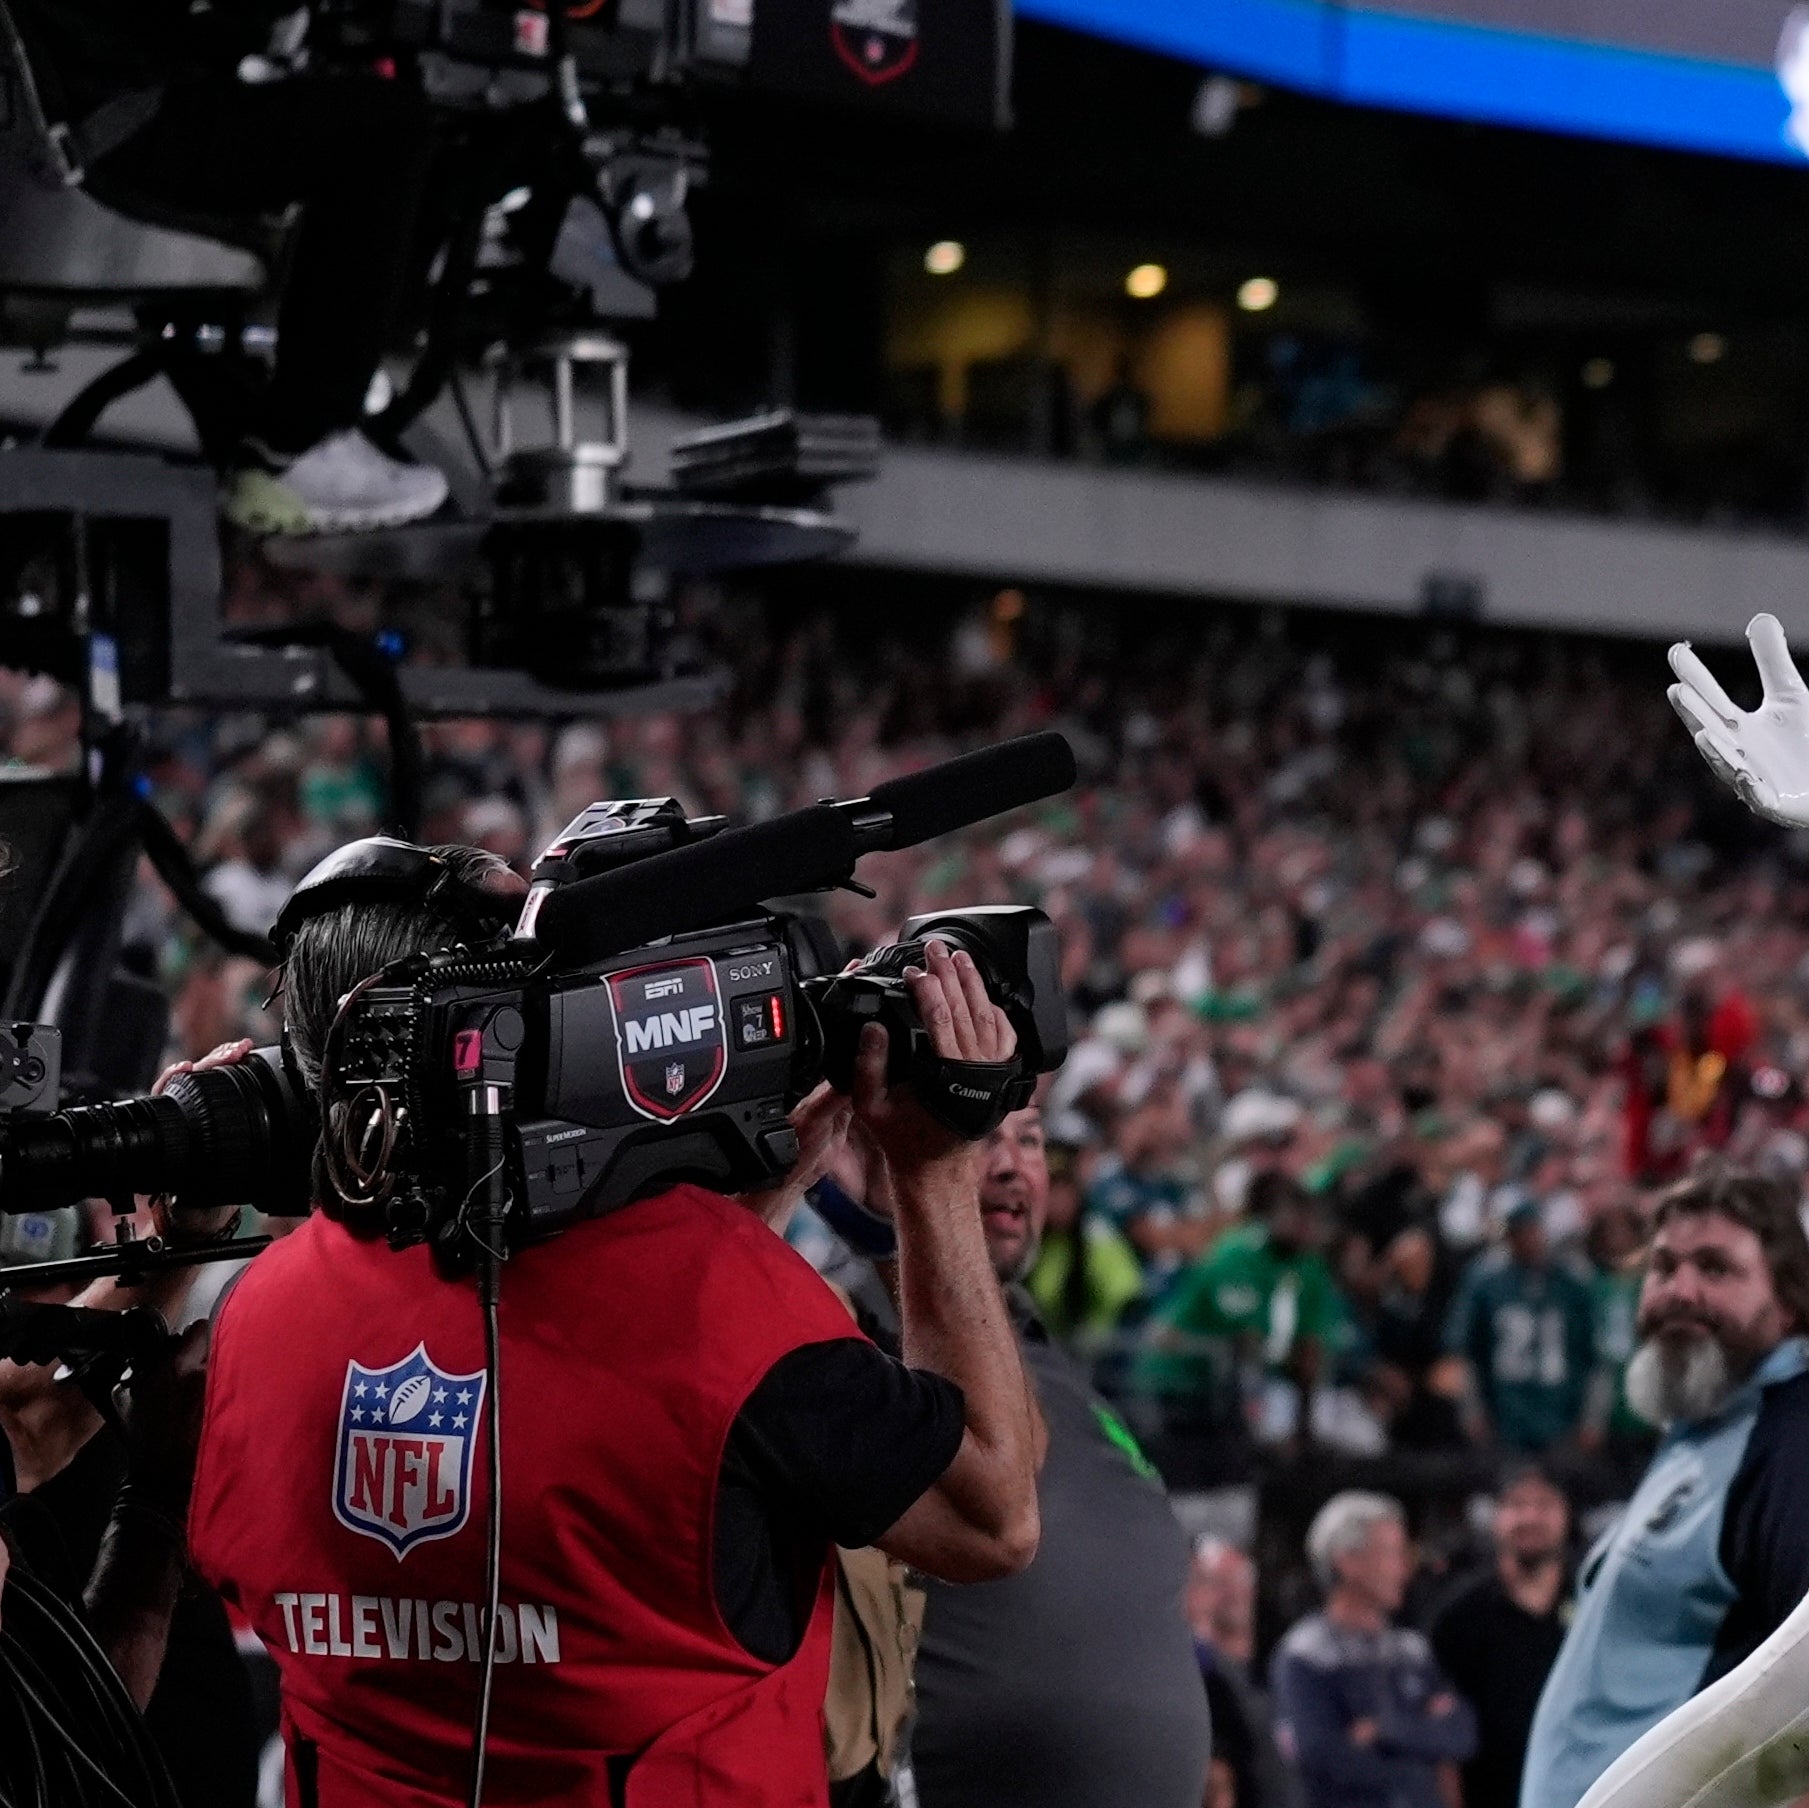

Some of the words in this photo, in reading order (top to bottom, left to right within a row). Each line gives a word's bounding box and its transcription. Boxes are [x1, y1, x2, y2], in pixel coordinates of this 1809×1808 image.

[729, 961, 773, 981] SONY
[644, 977, 684, 1000] ESPN
[624, 1004, 715, 1054] MNF
[458, 1033, 474, 1066] 7
[948, 1083, 992, 1101] Canon
[350, 1435, 455, 1530] NFL
[274, 1592, 560, 1665] TELEVISION
